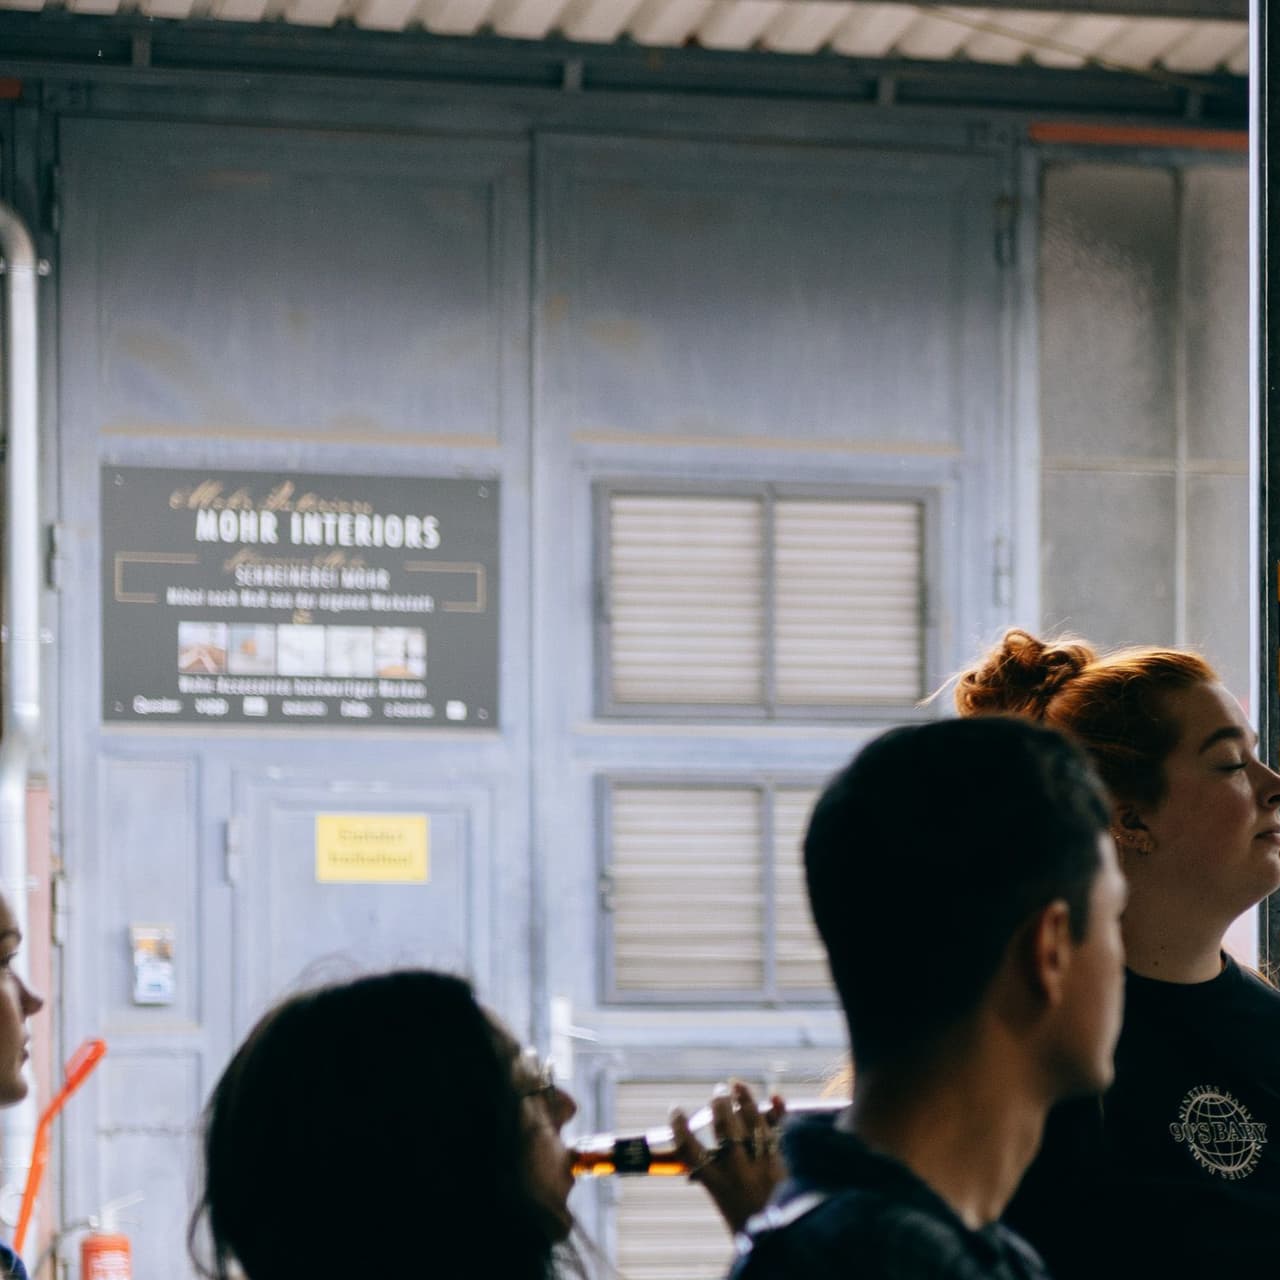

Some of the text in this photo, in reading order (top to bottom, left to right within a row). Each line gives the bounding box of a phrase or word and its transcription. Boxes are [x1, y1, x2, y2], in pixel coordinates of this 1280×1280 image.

[196, 509, 440, 548] MOHR INTERIORS
[1169, 1121, 1268, 1144] 90'S BABY
